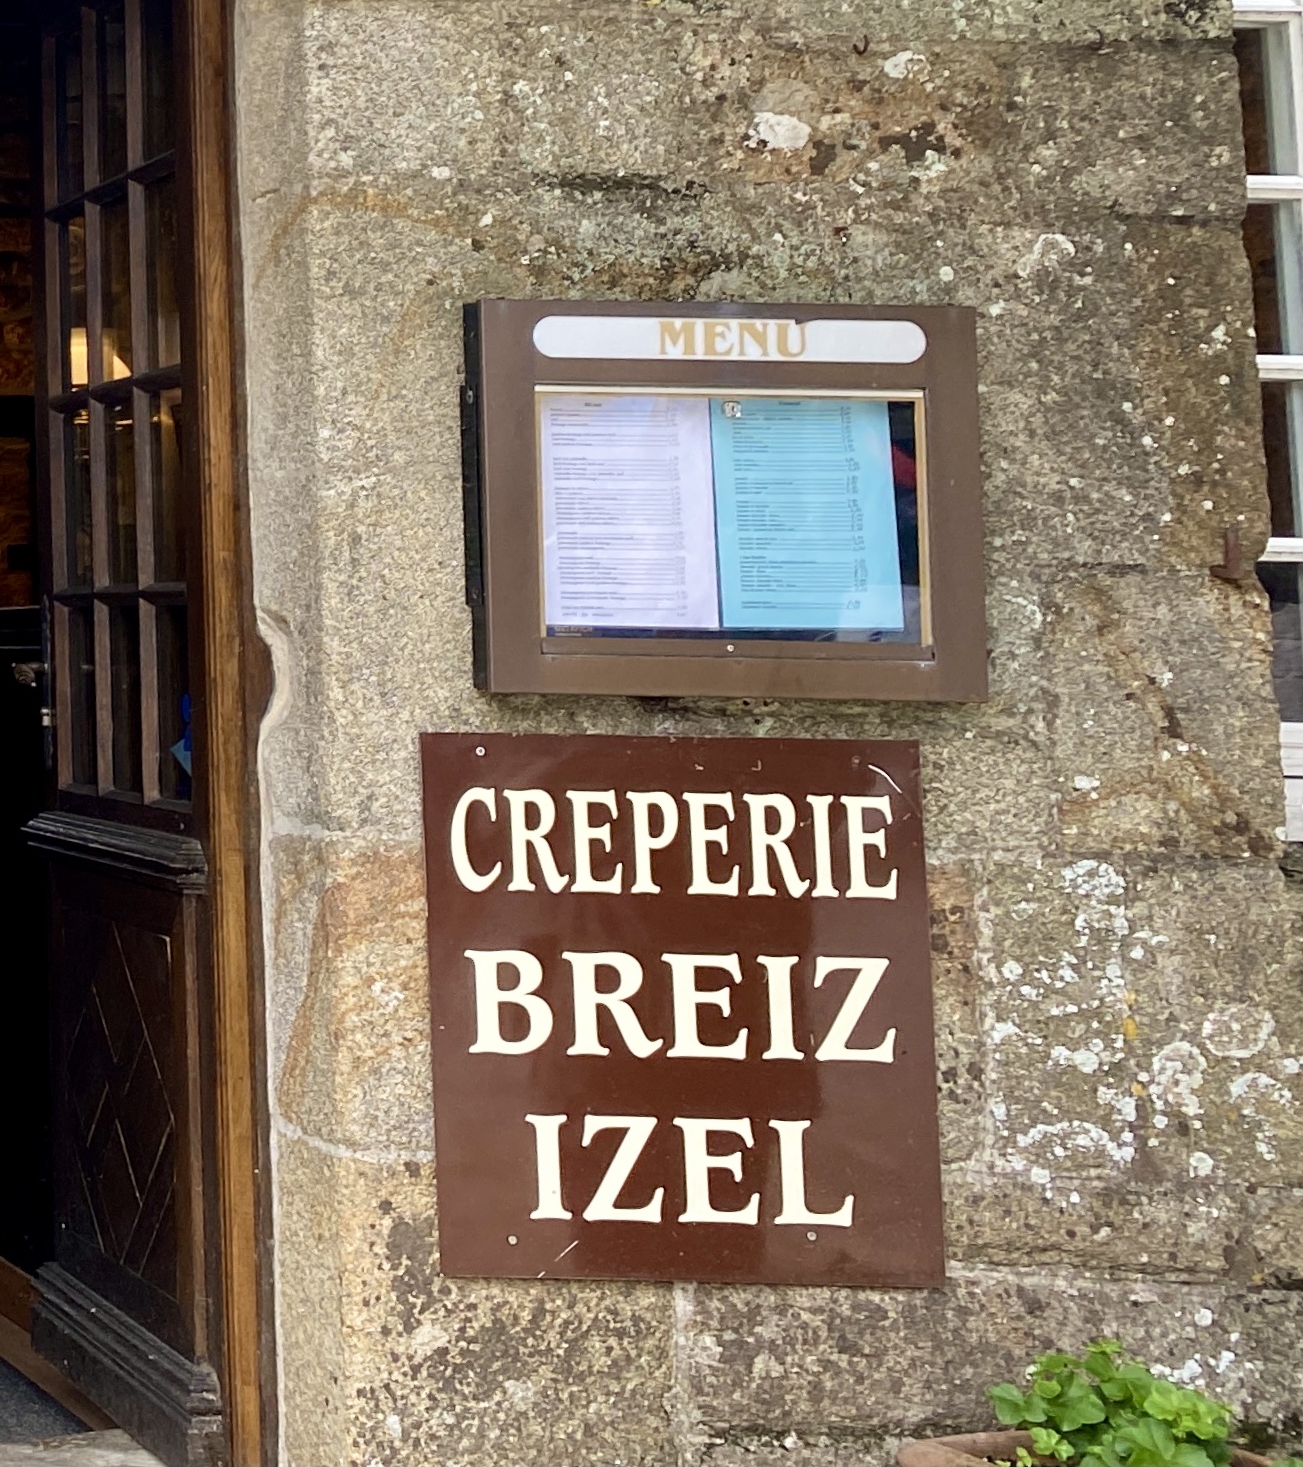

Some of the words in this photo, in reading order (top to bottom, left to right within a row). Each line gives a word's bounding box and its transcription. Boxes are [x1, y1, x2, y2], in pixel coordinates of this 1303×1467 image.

[658, 319, 808, 359] MENU
[449, 786, 899, 901] CREPERIE
[463, 948, 897, 1064] BREIZ
[524, 1113, 855, 1228] IZEL
